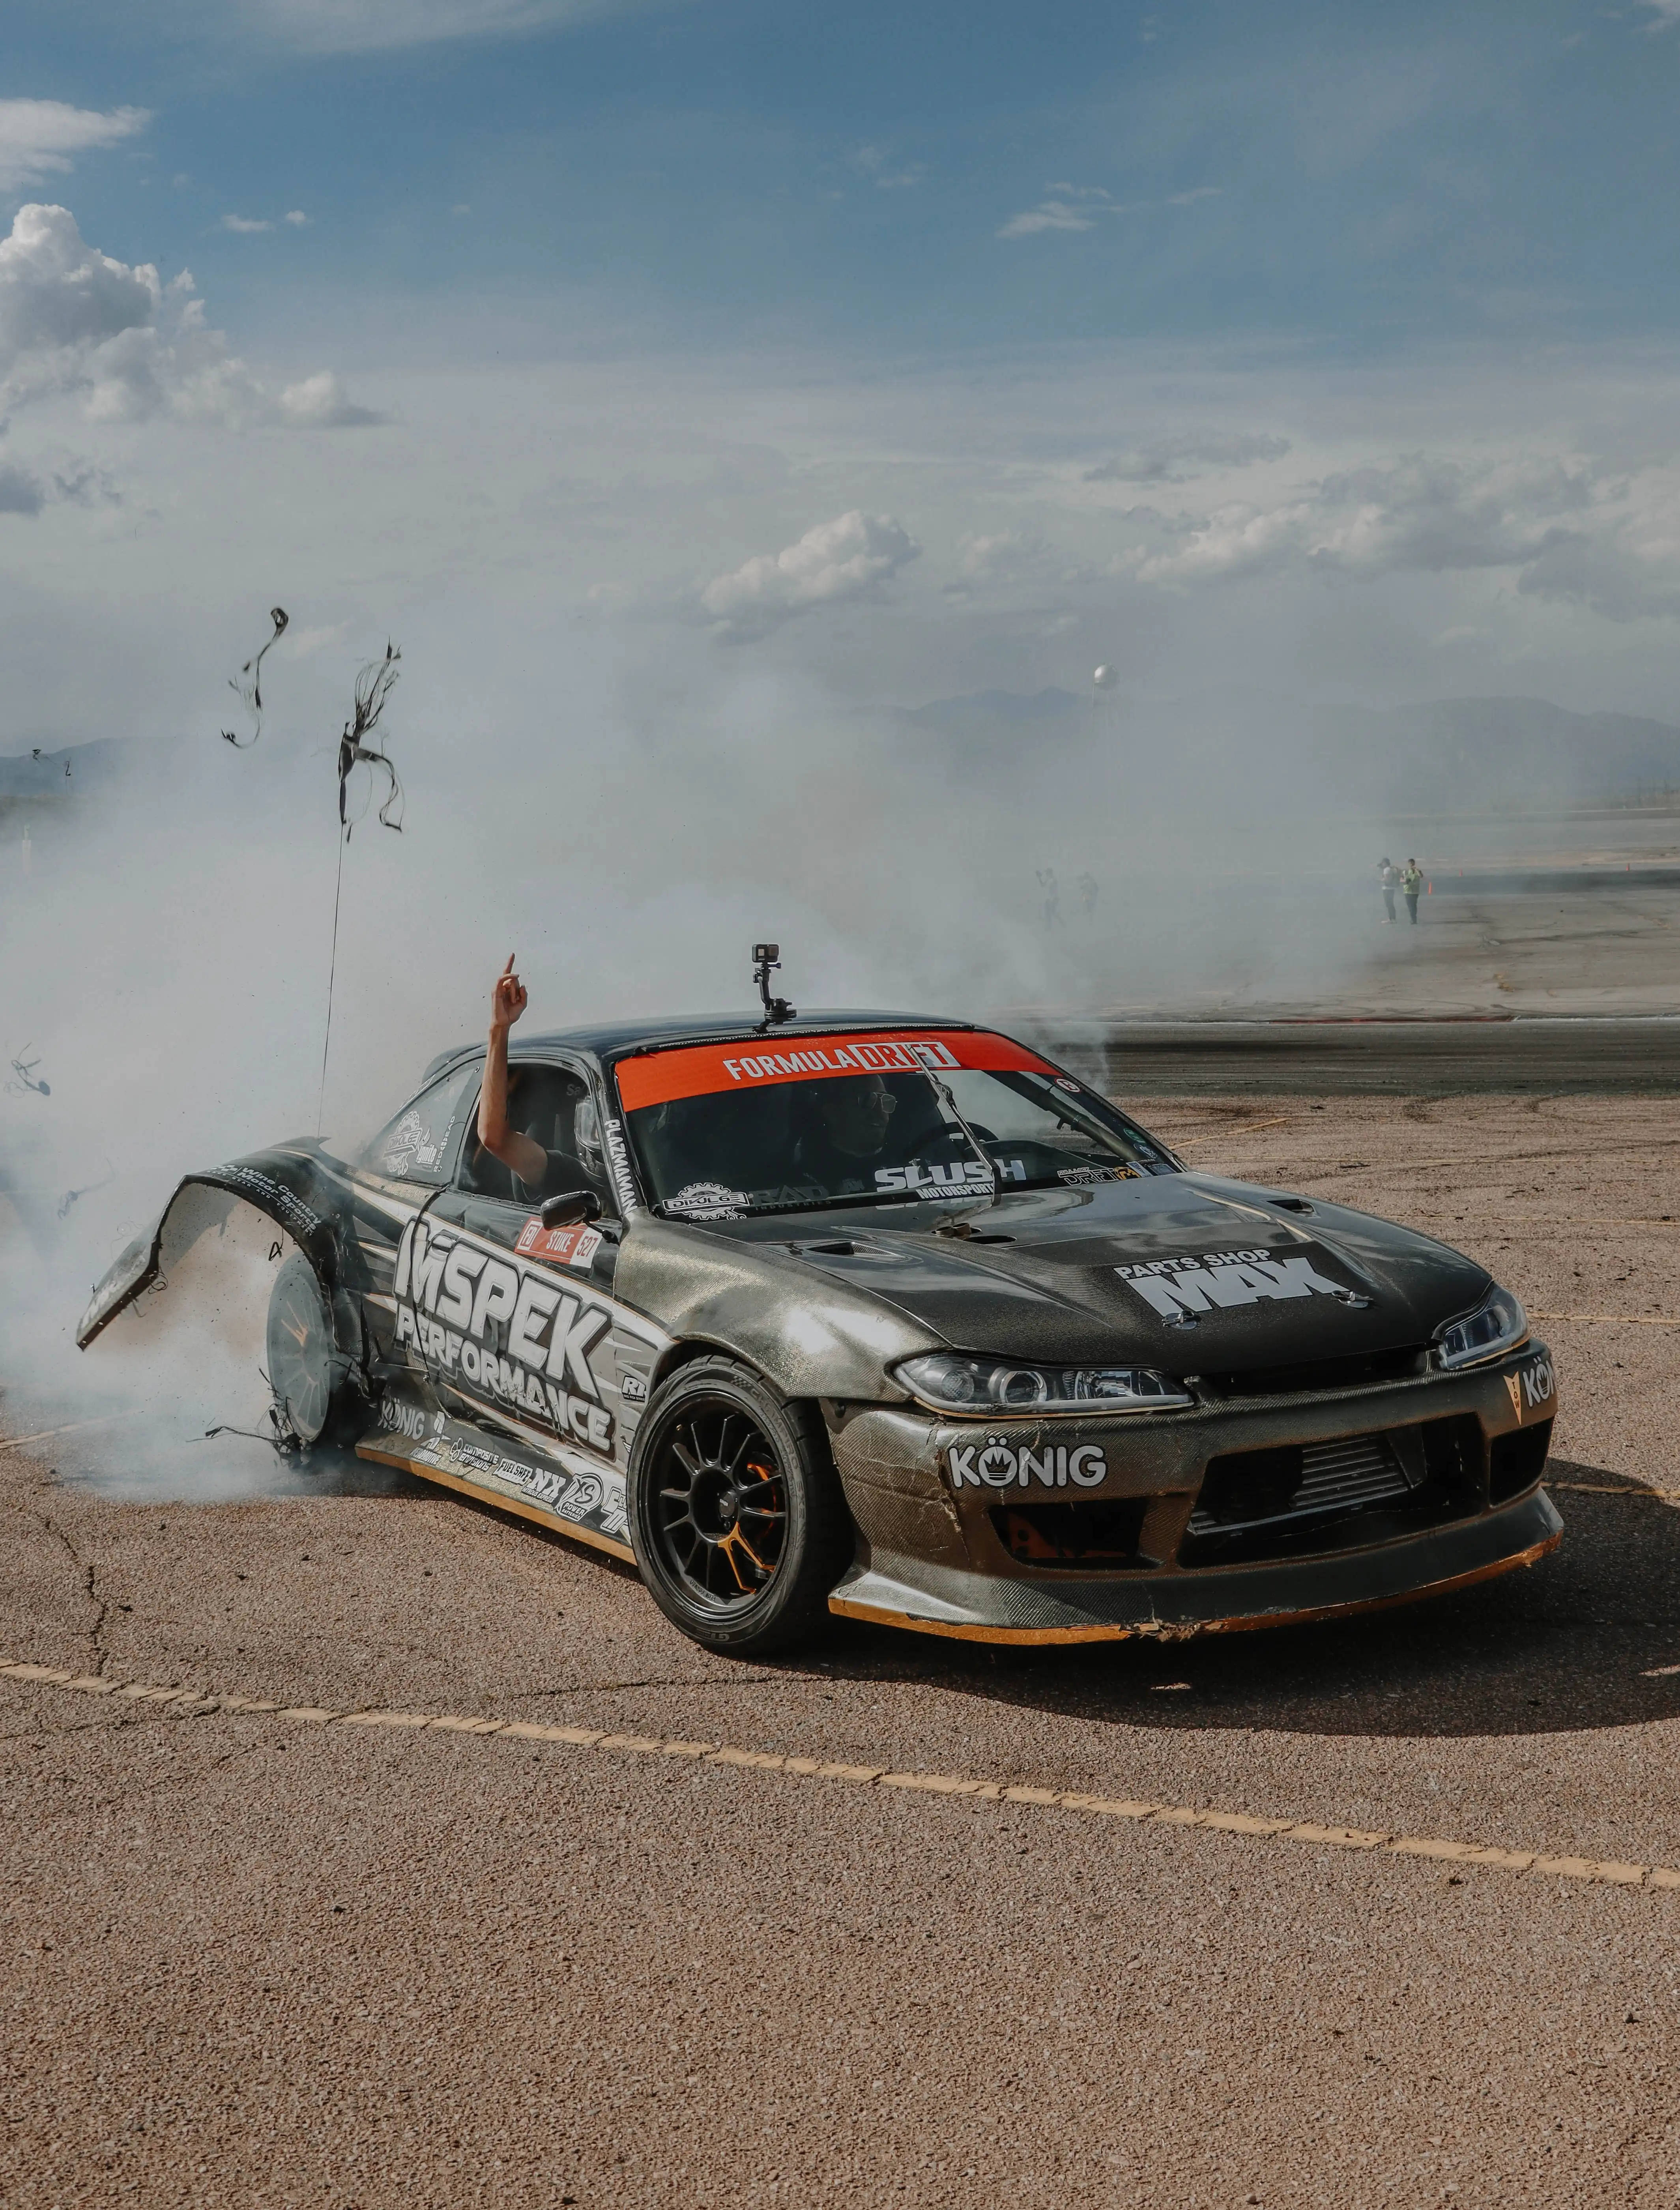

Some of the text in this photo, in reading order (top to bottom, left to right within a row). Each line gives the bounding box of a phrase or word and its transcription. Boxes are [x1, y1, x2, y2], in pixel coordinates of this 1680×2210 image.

[723, 1043, 949, 1080] FORMULA DRIFT
[242, 1168, 275, 1185] Wine
[604, 1119, 638, 1215] PLAZMAMAN
[875, 1158, 1027, 1192] SLUSH
[237, 1172, 279, 1194] Motor
[256, 1189, 270, 1199] AND
[915, 1183, 994, 1199] MOTORSPORT
[546, 1231, 575, 1253] STUKE
[576, 1235, 599, 1257] 527
[1113, 1249, 1271, 1280] PARTS SHOP
[1125, 1257, 1351, 1317] MAX
[396, 1303, 612, 1451] PERFORMANCE
[458, 1453, 492, 1471] ENVISIONS
[462, 1443, 500, 1465] COMPOSITE
[949, 1437, 1106, 1488] KÖNIG
[522, 1487, 554, 1503] NITROUS EXPRESS
[527, 1467, 566, 1499] NX
[561, 1508, 581, 1519] BATTERIES
[563, 1502, 586, 1516] POWER
